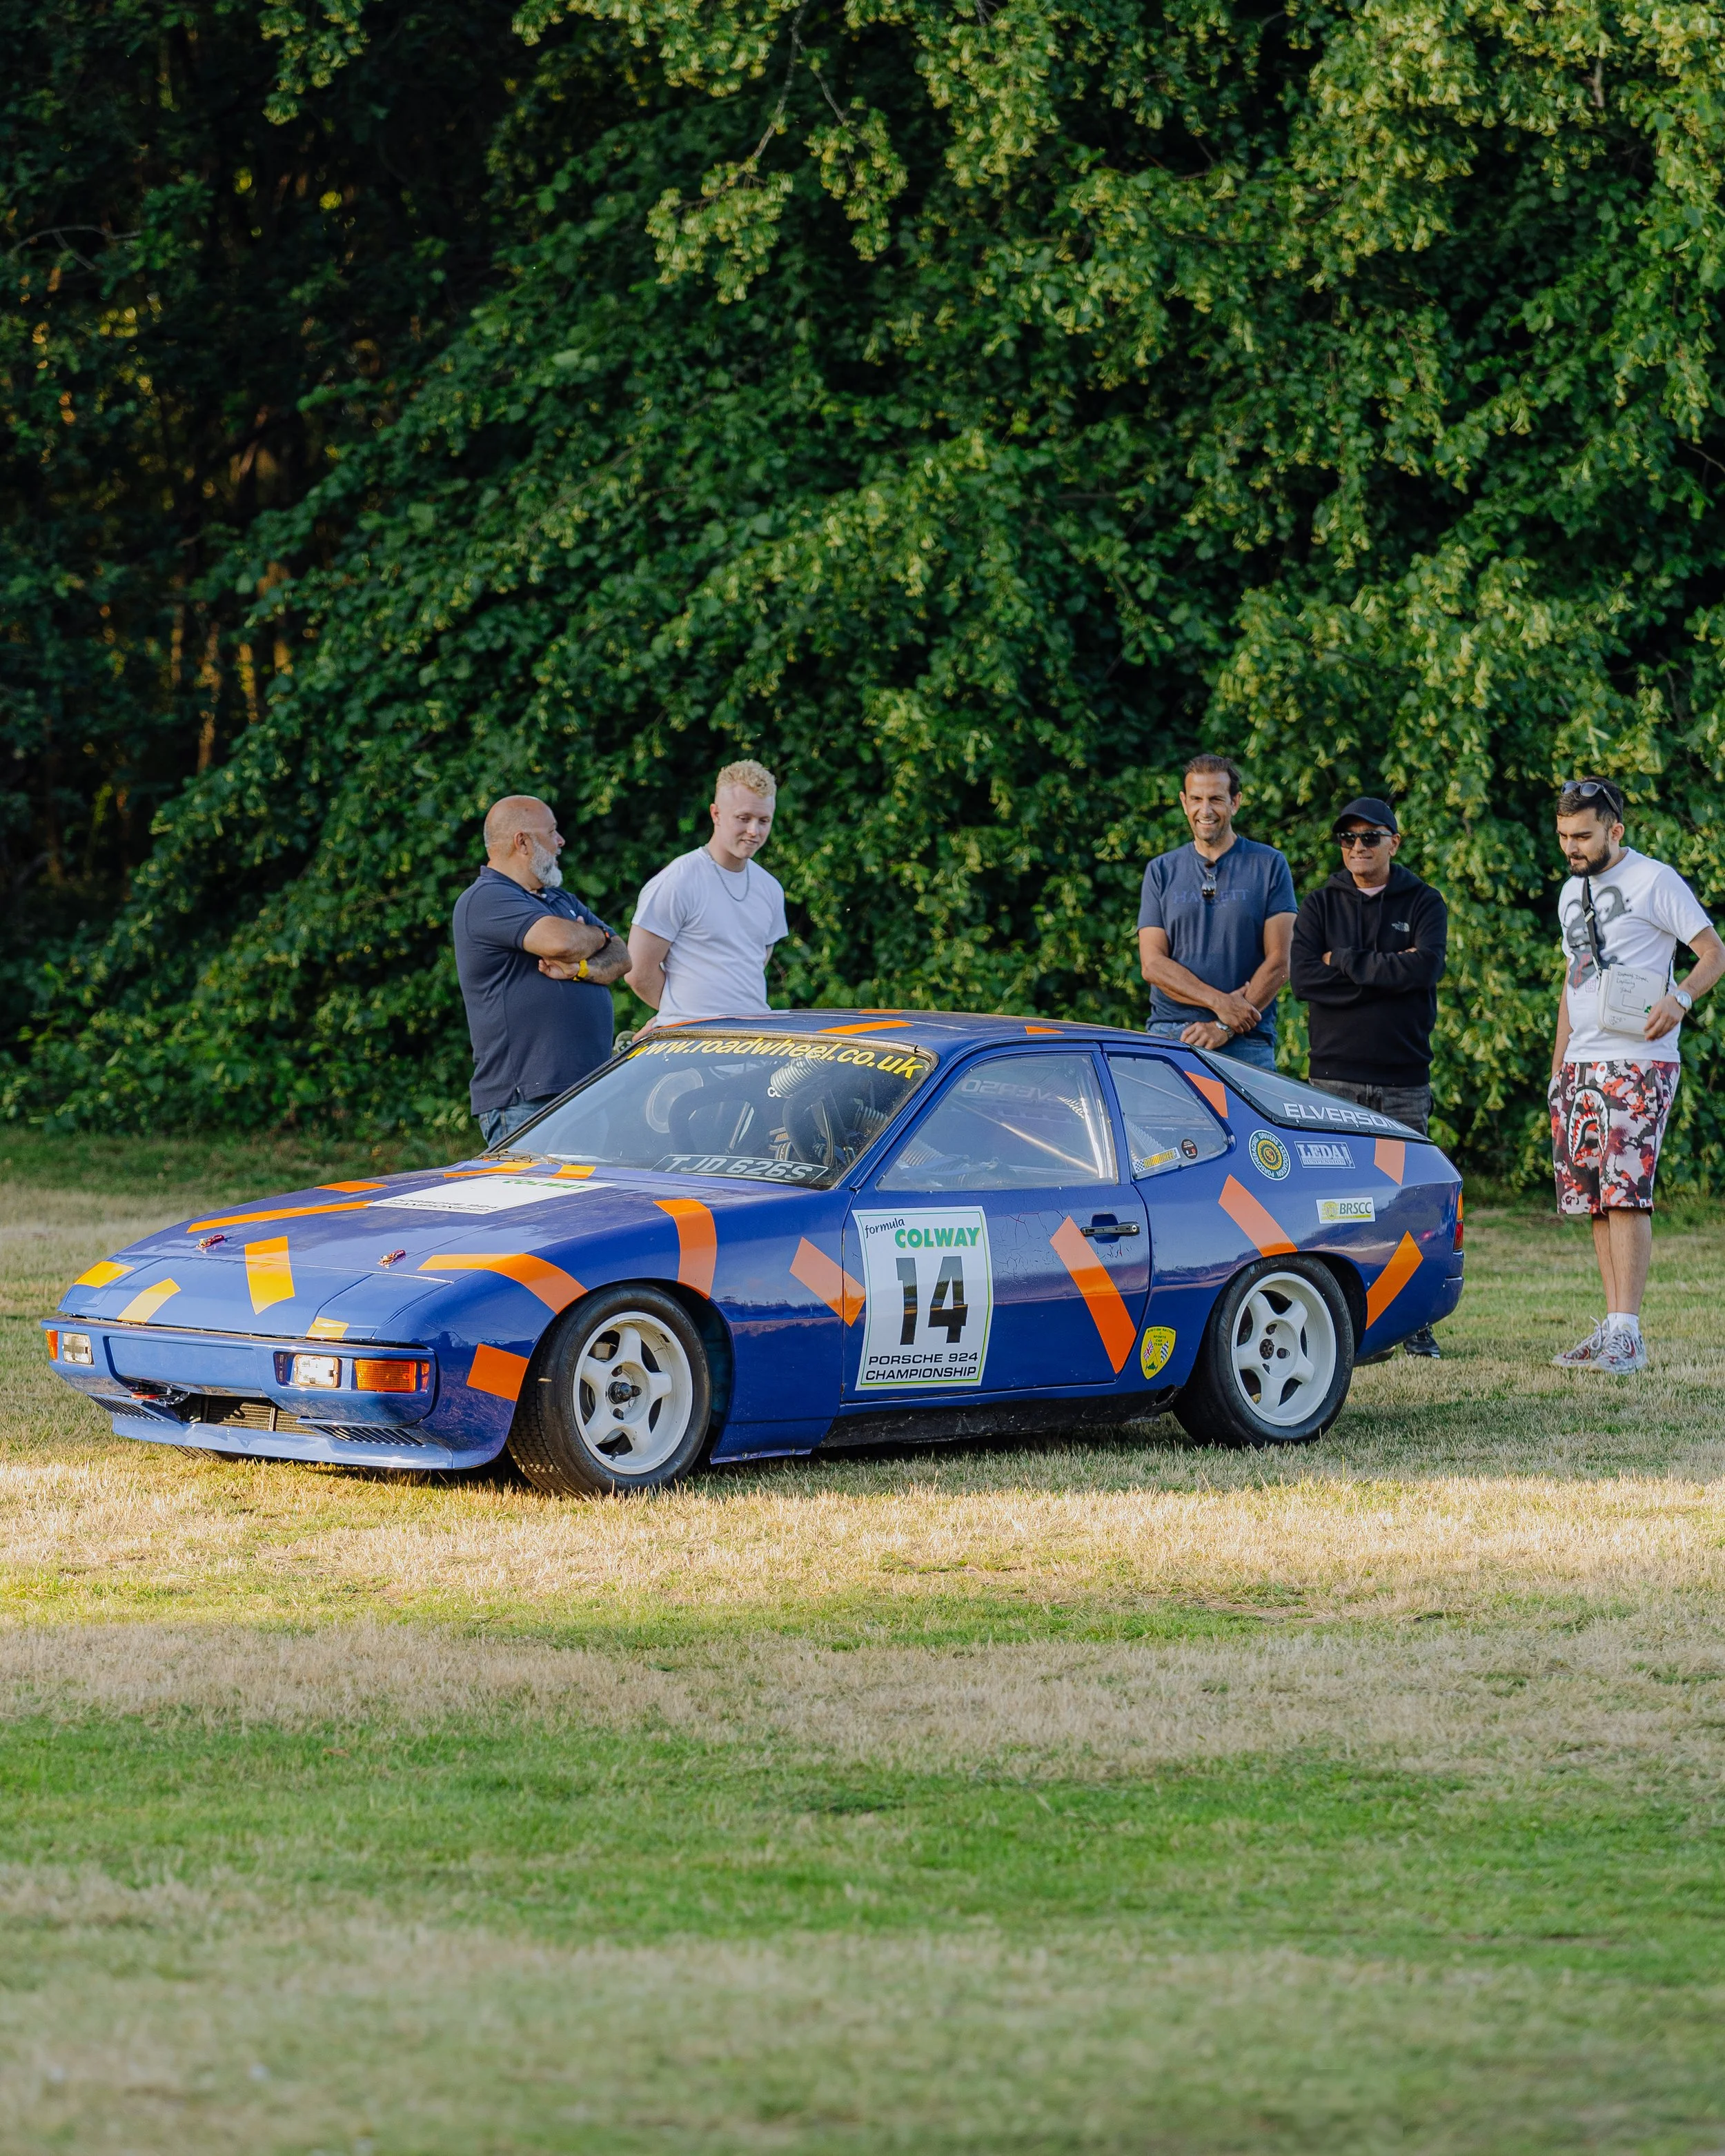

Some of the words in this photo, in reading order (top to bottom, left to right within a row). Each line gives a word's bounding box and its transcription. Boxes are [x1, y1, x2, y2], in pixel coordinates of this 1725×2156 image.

[1173, 889, 1250, 904] HAETT
[627, 1037, 923, 1079] www.roadwheel.co.uk
[1283, 1102, 1402, 1131] ELVERSON
[1251, 1136, 1259, 1156] RACING
[1258, 1132, 1279, 1145] DRIVERS
[1276, 1145, 1289, 1178] ASSOCIATION
[1297, 1144, 1345, 1159] LEDA
[664, 1156, 727, 1172] TJD
[726, 1159, 813, 1180] 626S
[1339, 1202, 1372, 1214] BRSCC
[865, 1217, 906, 1239] formula
[894, 1227, 981, 1249] COLWAY
[895, 1255, 969, 1346] 14
[868, 1353, 943, 1366] PORSCHE
[948, 1352, 978, 1363] 924
[865, 1367, 976, 1381] CHAMPIONSHIP
